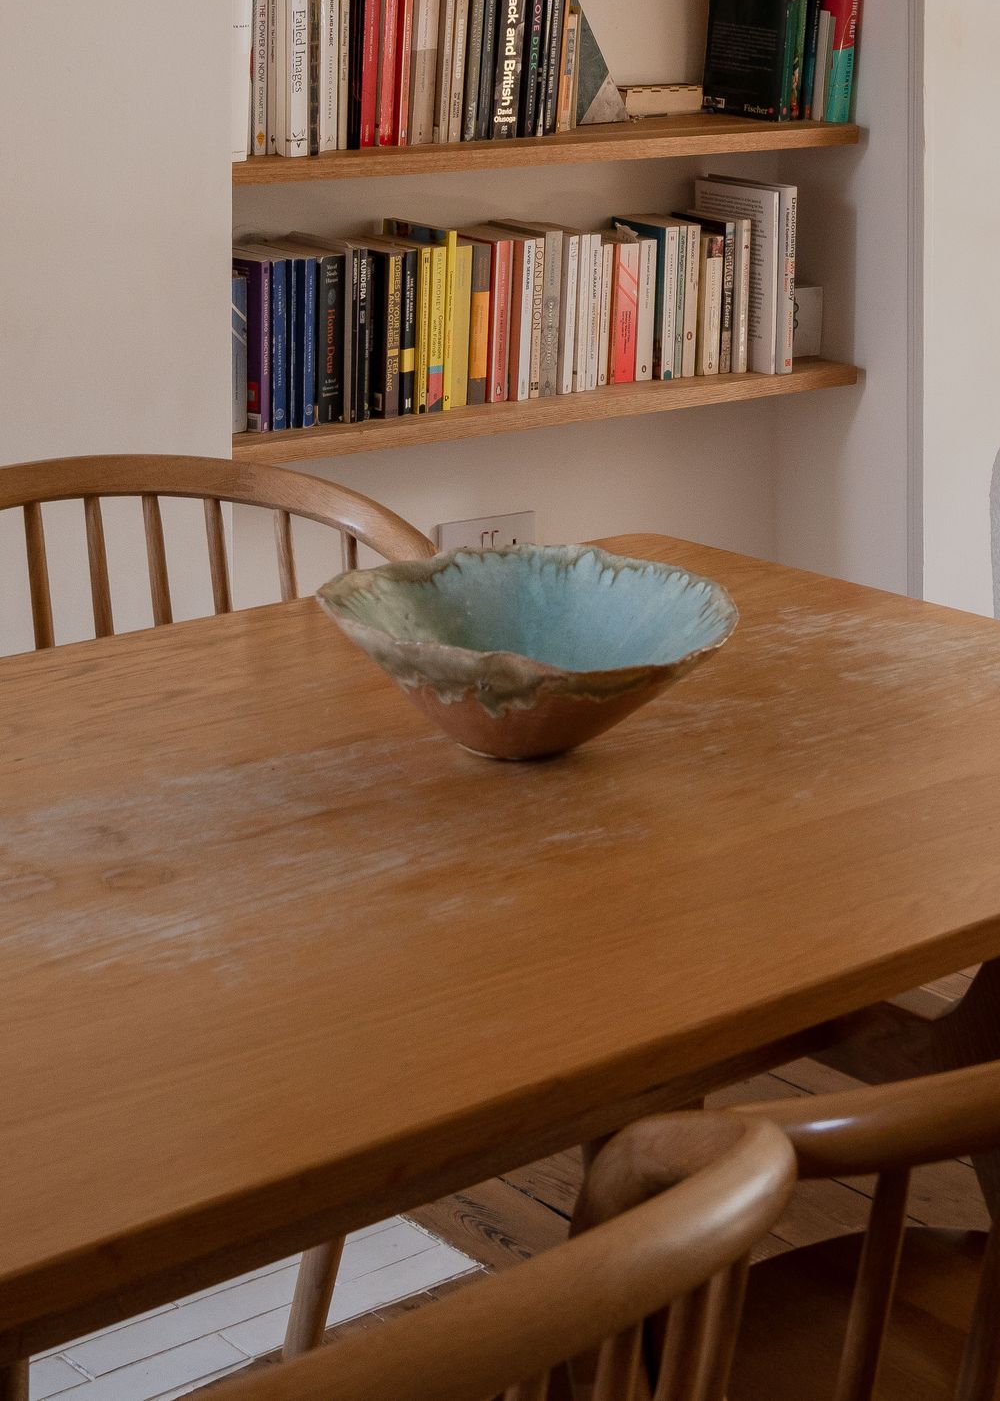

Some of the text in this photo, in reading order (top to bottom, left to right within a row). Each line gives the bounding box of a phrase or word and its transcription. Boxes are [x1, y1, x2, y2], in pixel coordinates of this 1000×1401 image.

[258, 50, 265, 60] OF
[292, 10, 306, 93] Failed Images
[456, 18, 465, 80] BAUDRILLARD
[505, 28, 516, 55] and
[530, 37, 539, 70] DICK
[501, 60, 515, 106] British
[744, 104, 768, 115] Fischer
[725, 238, 733, 287] DISGRACE
[789, 261, 795, 274] My
[394, 292, 400, 300] OF
[533, 245, 543, 330] JOAN DIDION
